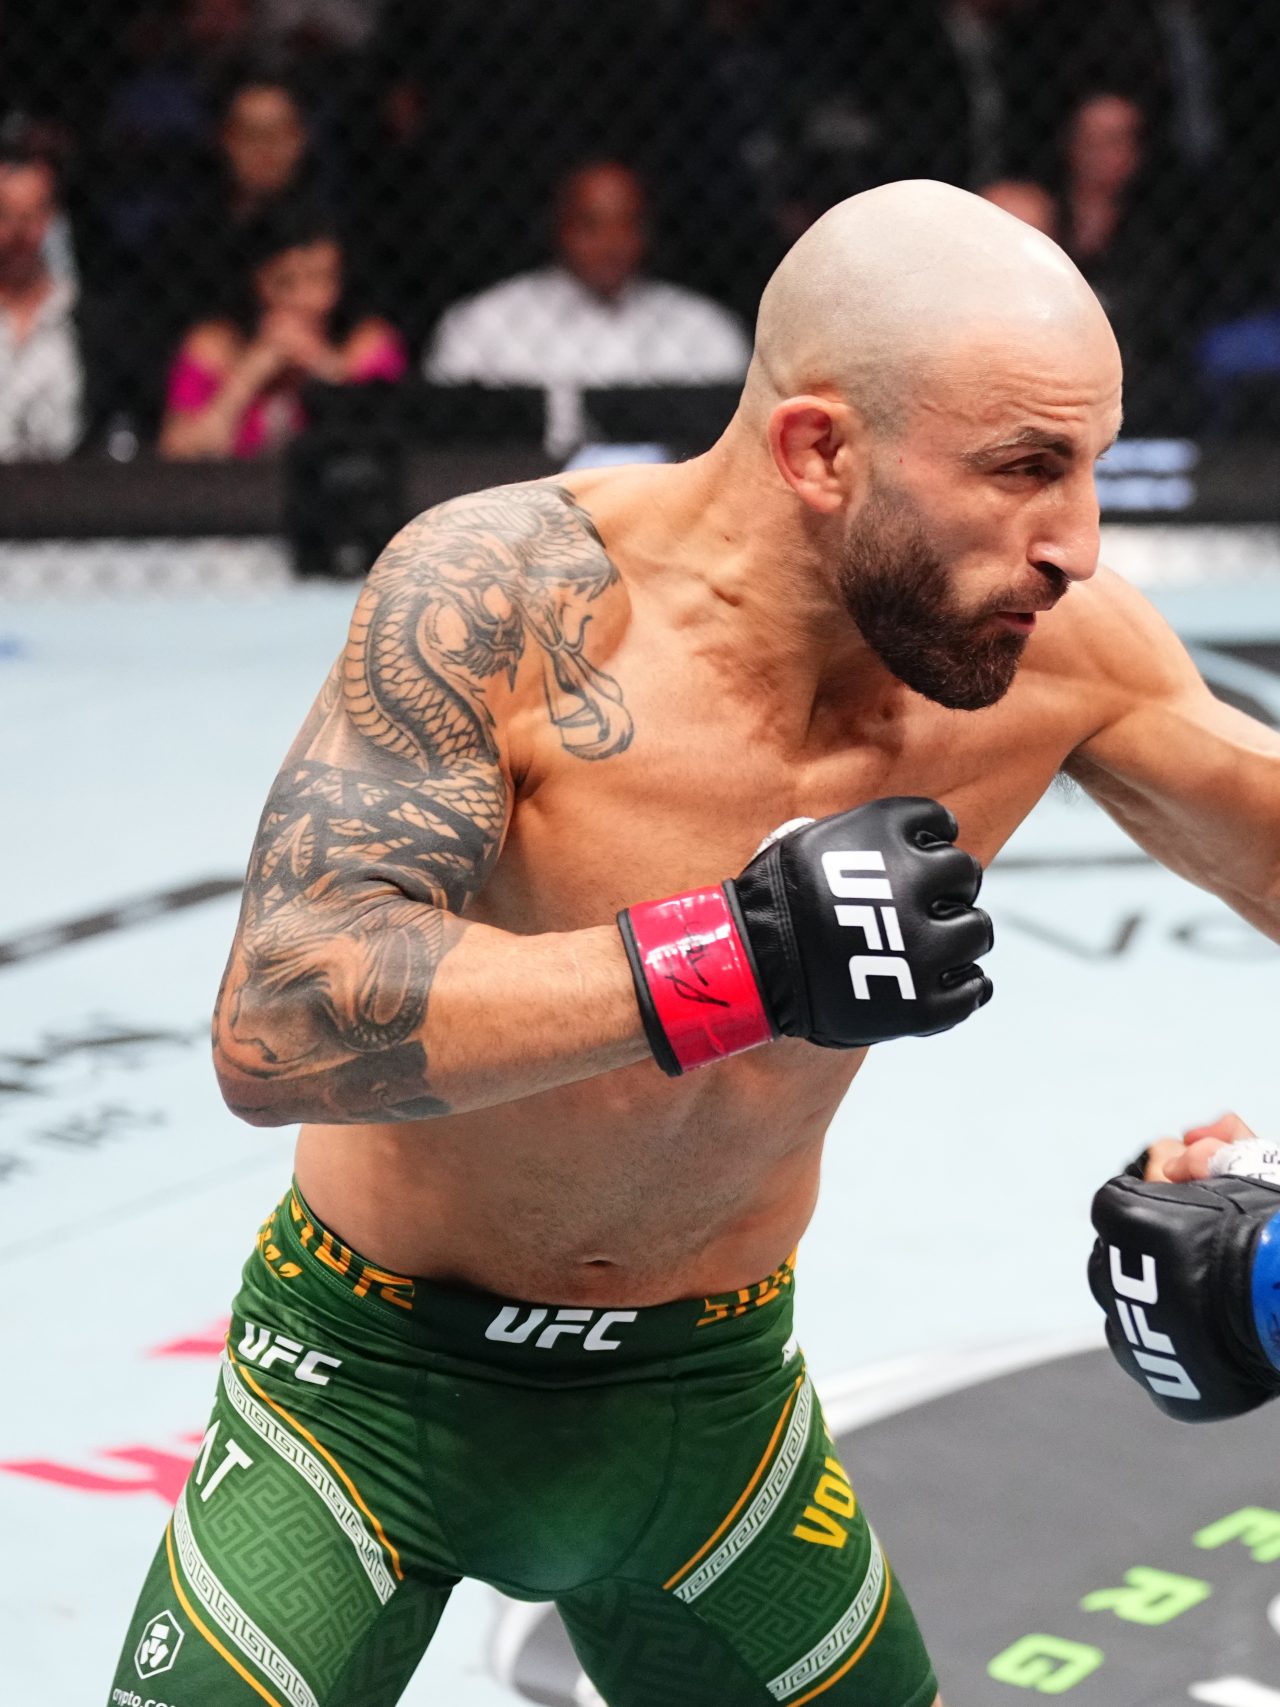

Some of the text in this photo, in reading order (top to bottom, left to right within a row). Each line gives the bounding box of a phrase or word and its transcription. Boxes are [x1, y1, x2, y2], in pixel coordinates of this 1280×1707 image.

[821, 851, 917, 1000] UFC
[238, 1321, 343, 1386] UFC
[485, 1306, 638, 1351] UFC
[1109, 1245, 1202, 1401] UFC
